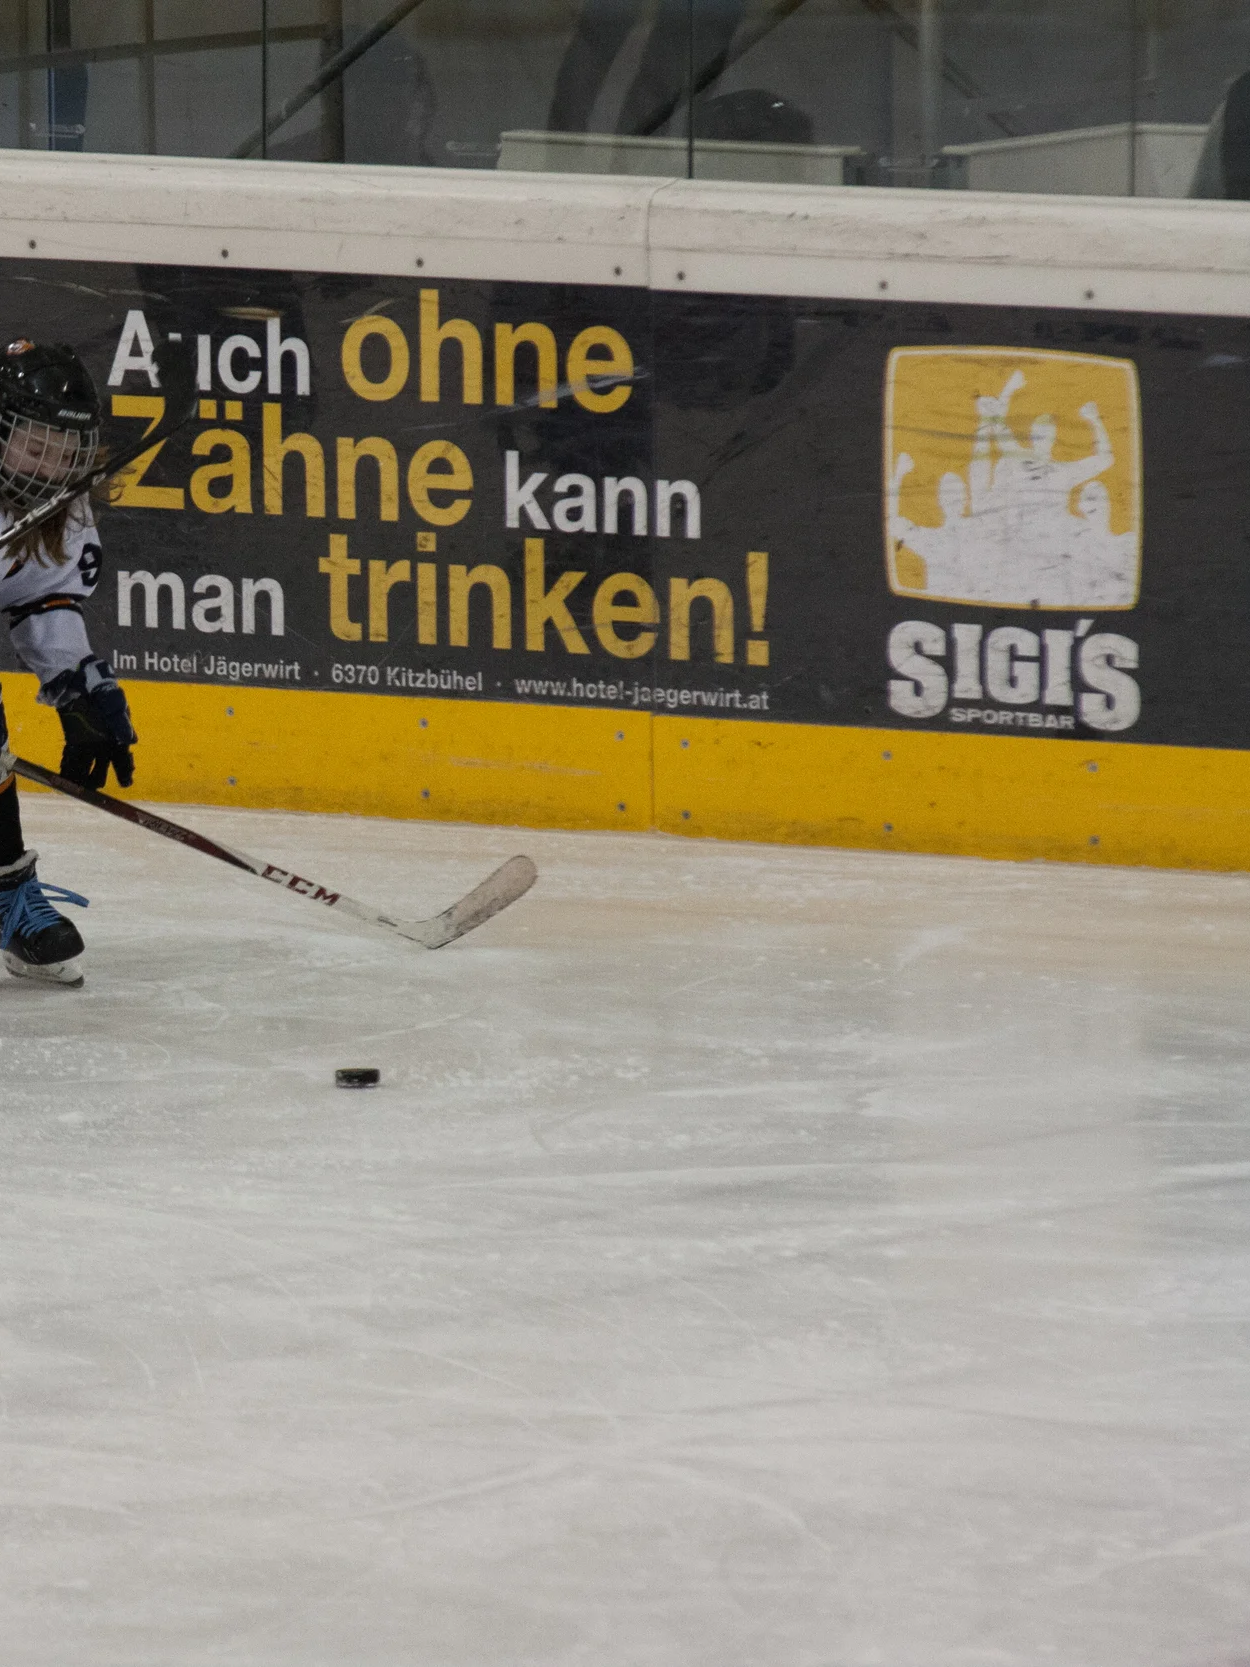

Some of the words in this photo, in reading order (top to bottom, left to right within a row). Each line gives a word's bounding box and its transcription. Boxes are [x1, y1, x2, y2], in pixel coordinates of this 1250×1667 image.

[341, 288, 636, 414] ohne
[110, 394, 475, 527] Zähne
[504, 450, 703, 539] kann
[77, 543, 103, 587] 9
[117, 569, 286, 637] man
[318, 531, 771, 667] trinken!
[113, 649, 138, 670] Im
[145, 651, 198, 673] Hotel
[204, 655, 301, 681] Jägerwirt
[331, 663, 380, 684] 6370
[386, 666, 483, 692] Kitzbühel
[514, 677, 770, 711] www.hotel-jaegerwirt.at
[886, 616, 1142, 732] SIGI'S
[950, 708, 1076, 731] SPORTBAR
[260, 863, 342, 907] CCM
